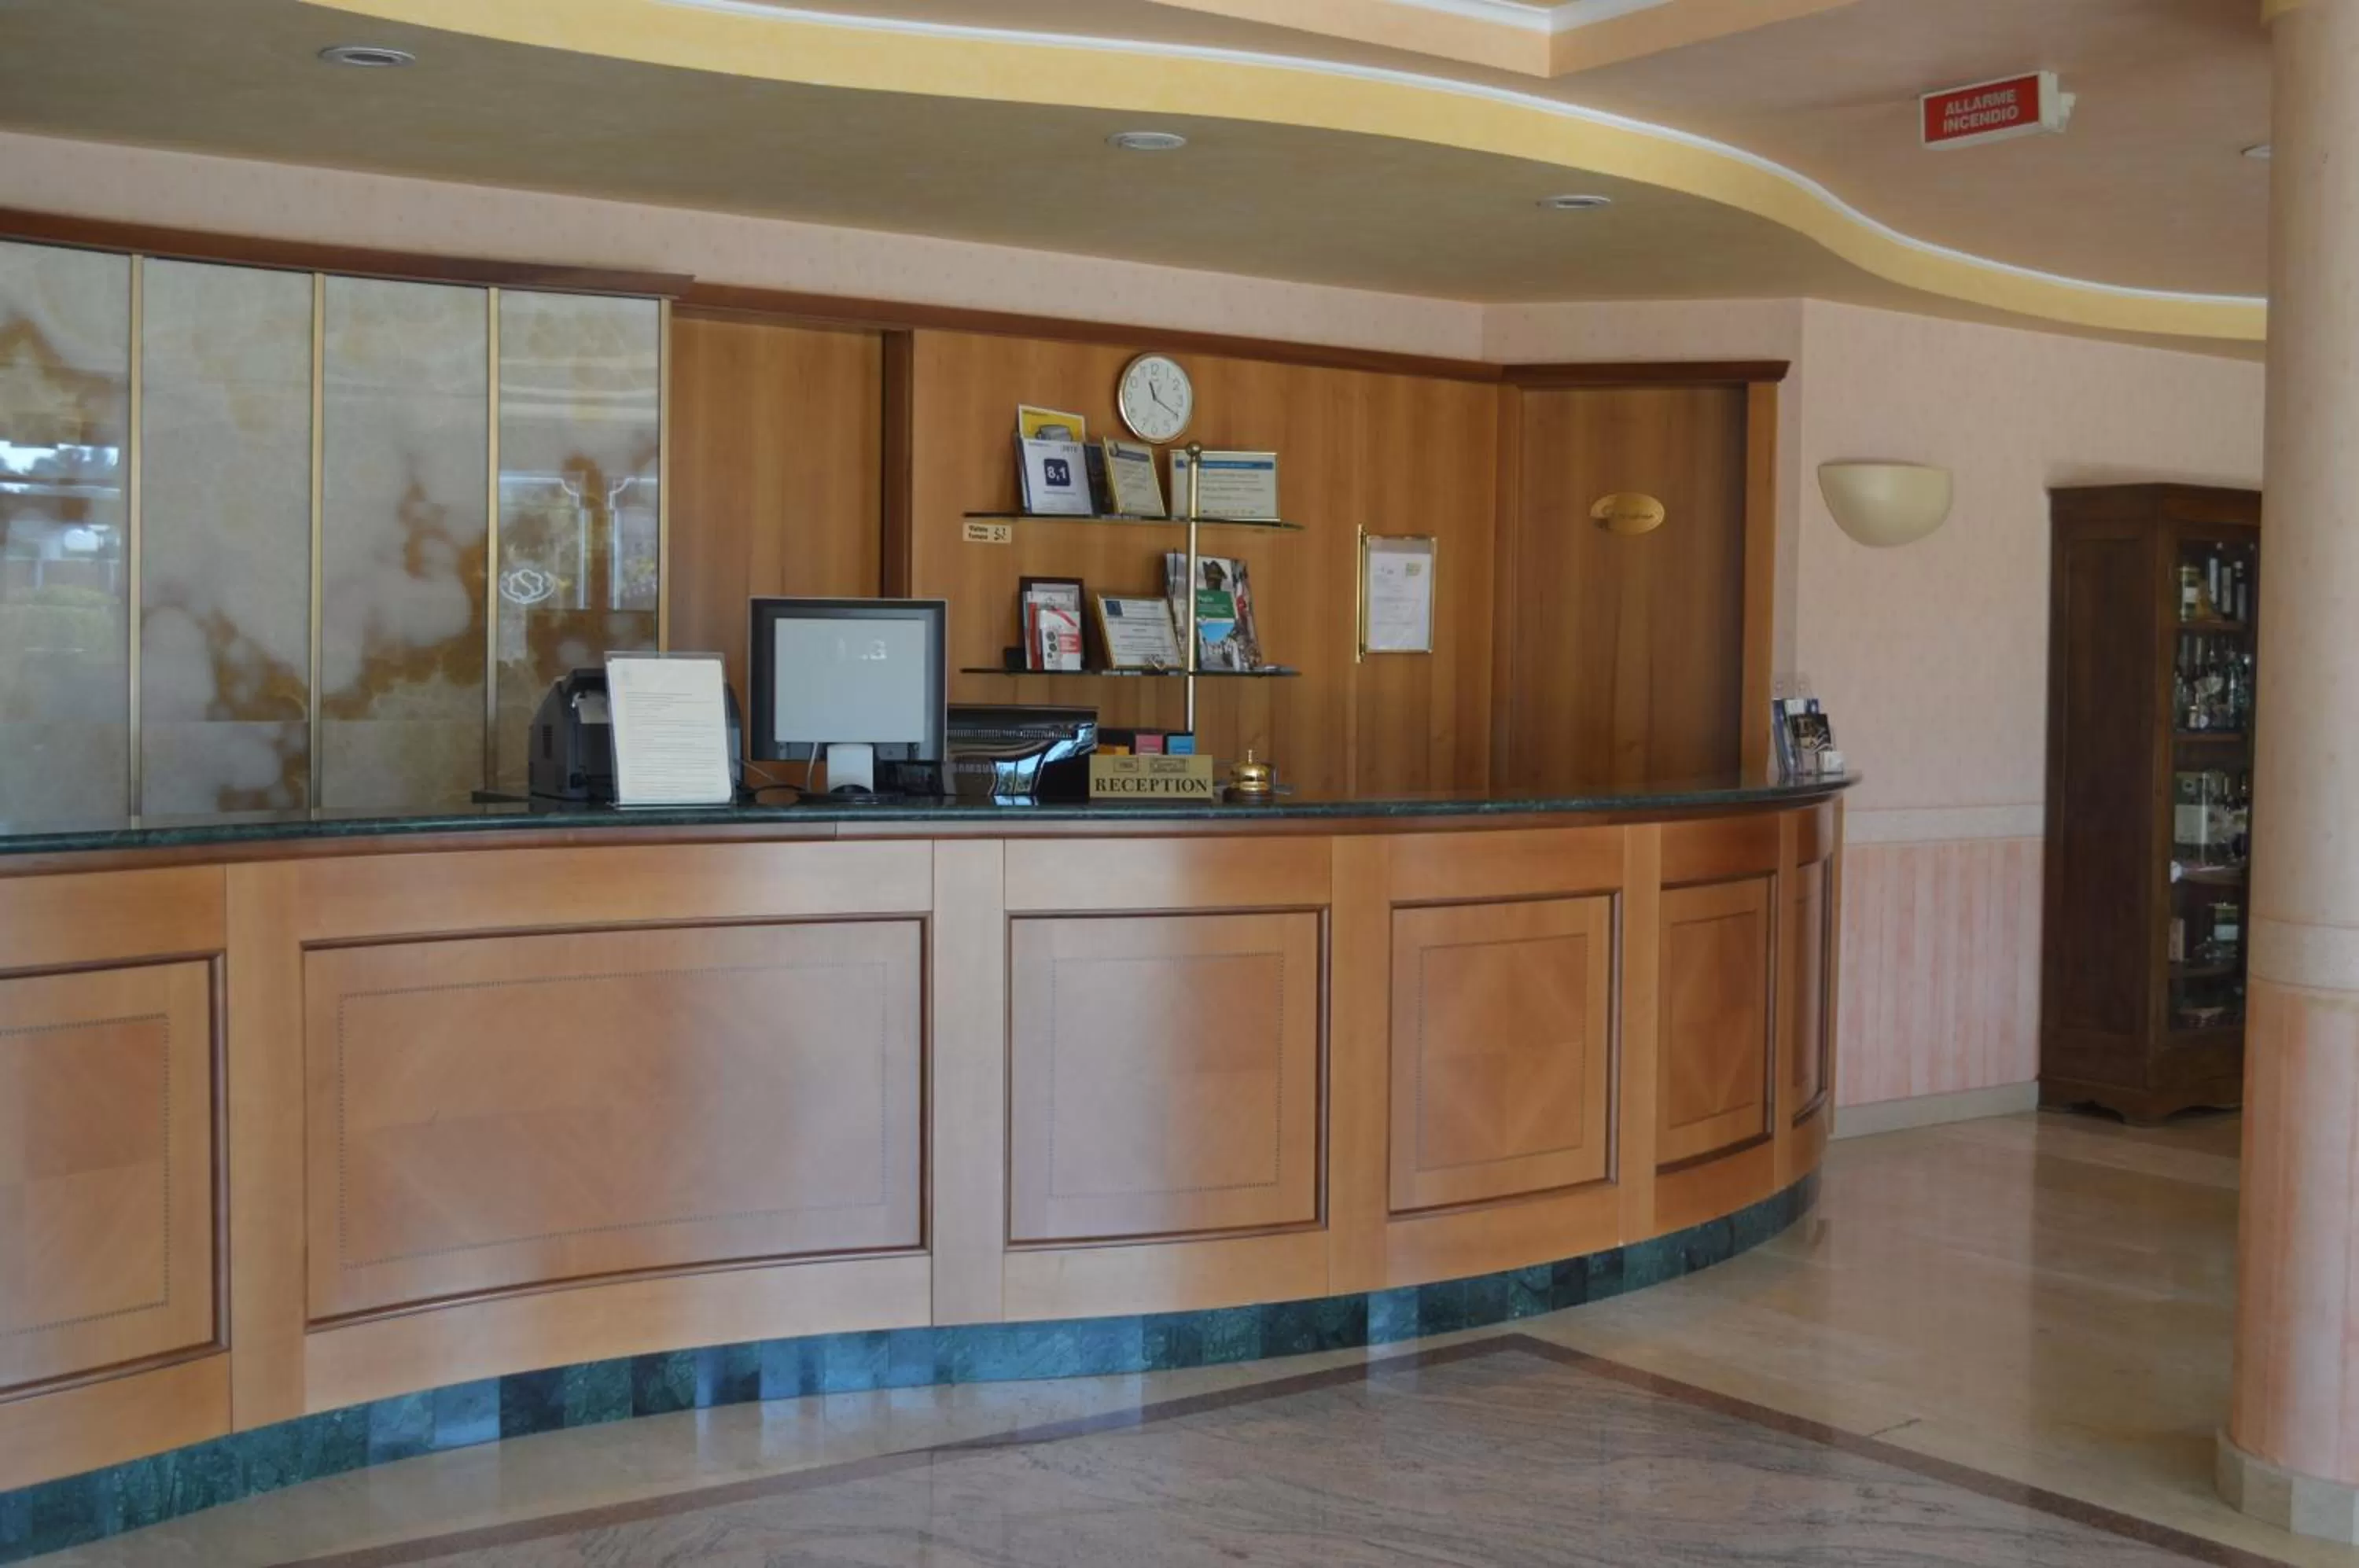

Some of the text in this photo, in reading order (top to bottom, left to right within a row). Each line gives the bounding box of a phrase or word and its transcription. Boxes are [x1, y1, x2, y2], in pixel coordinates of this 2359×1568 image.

[1945, 90, 2016, 115] ALLARME
[1943, 105, 2019, 133] INCENDIO
[1047, 466, 1067, 481] 8,1
[1095, 778, 1208, 793] RECEPTION
